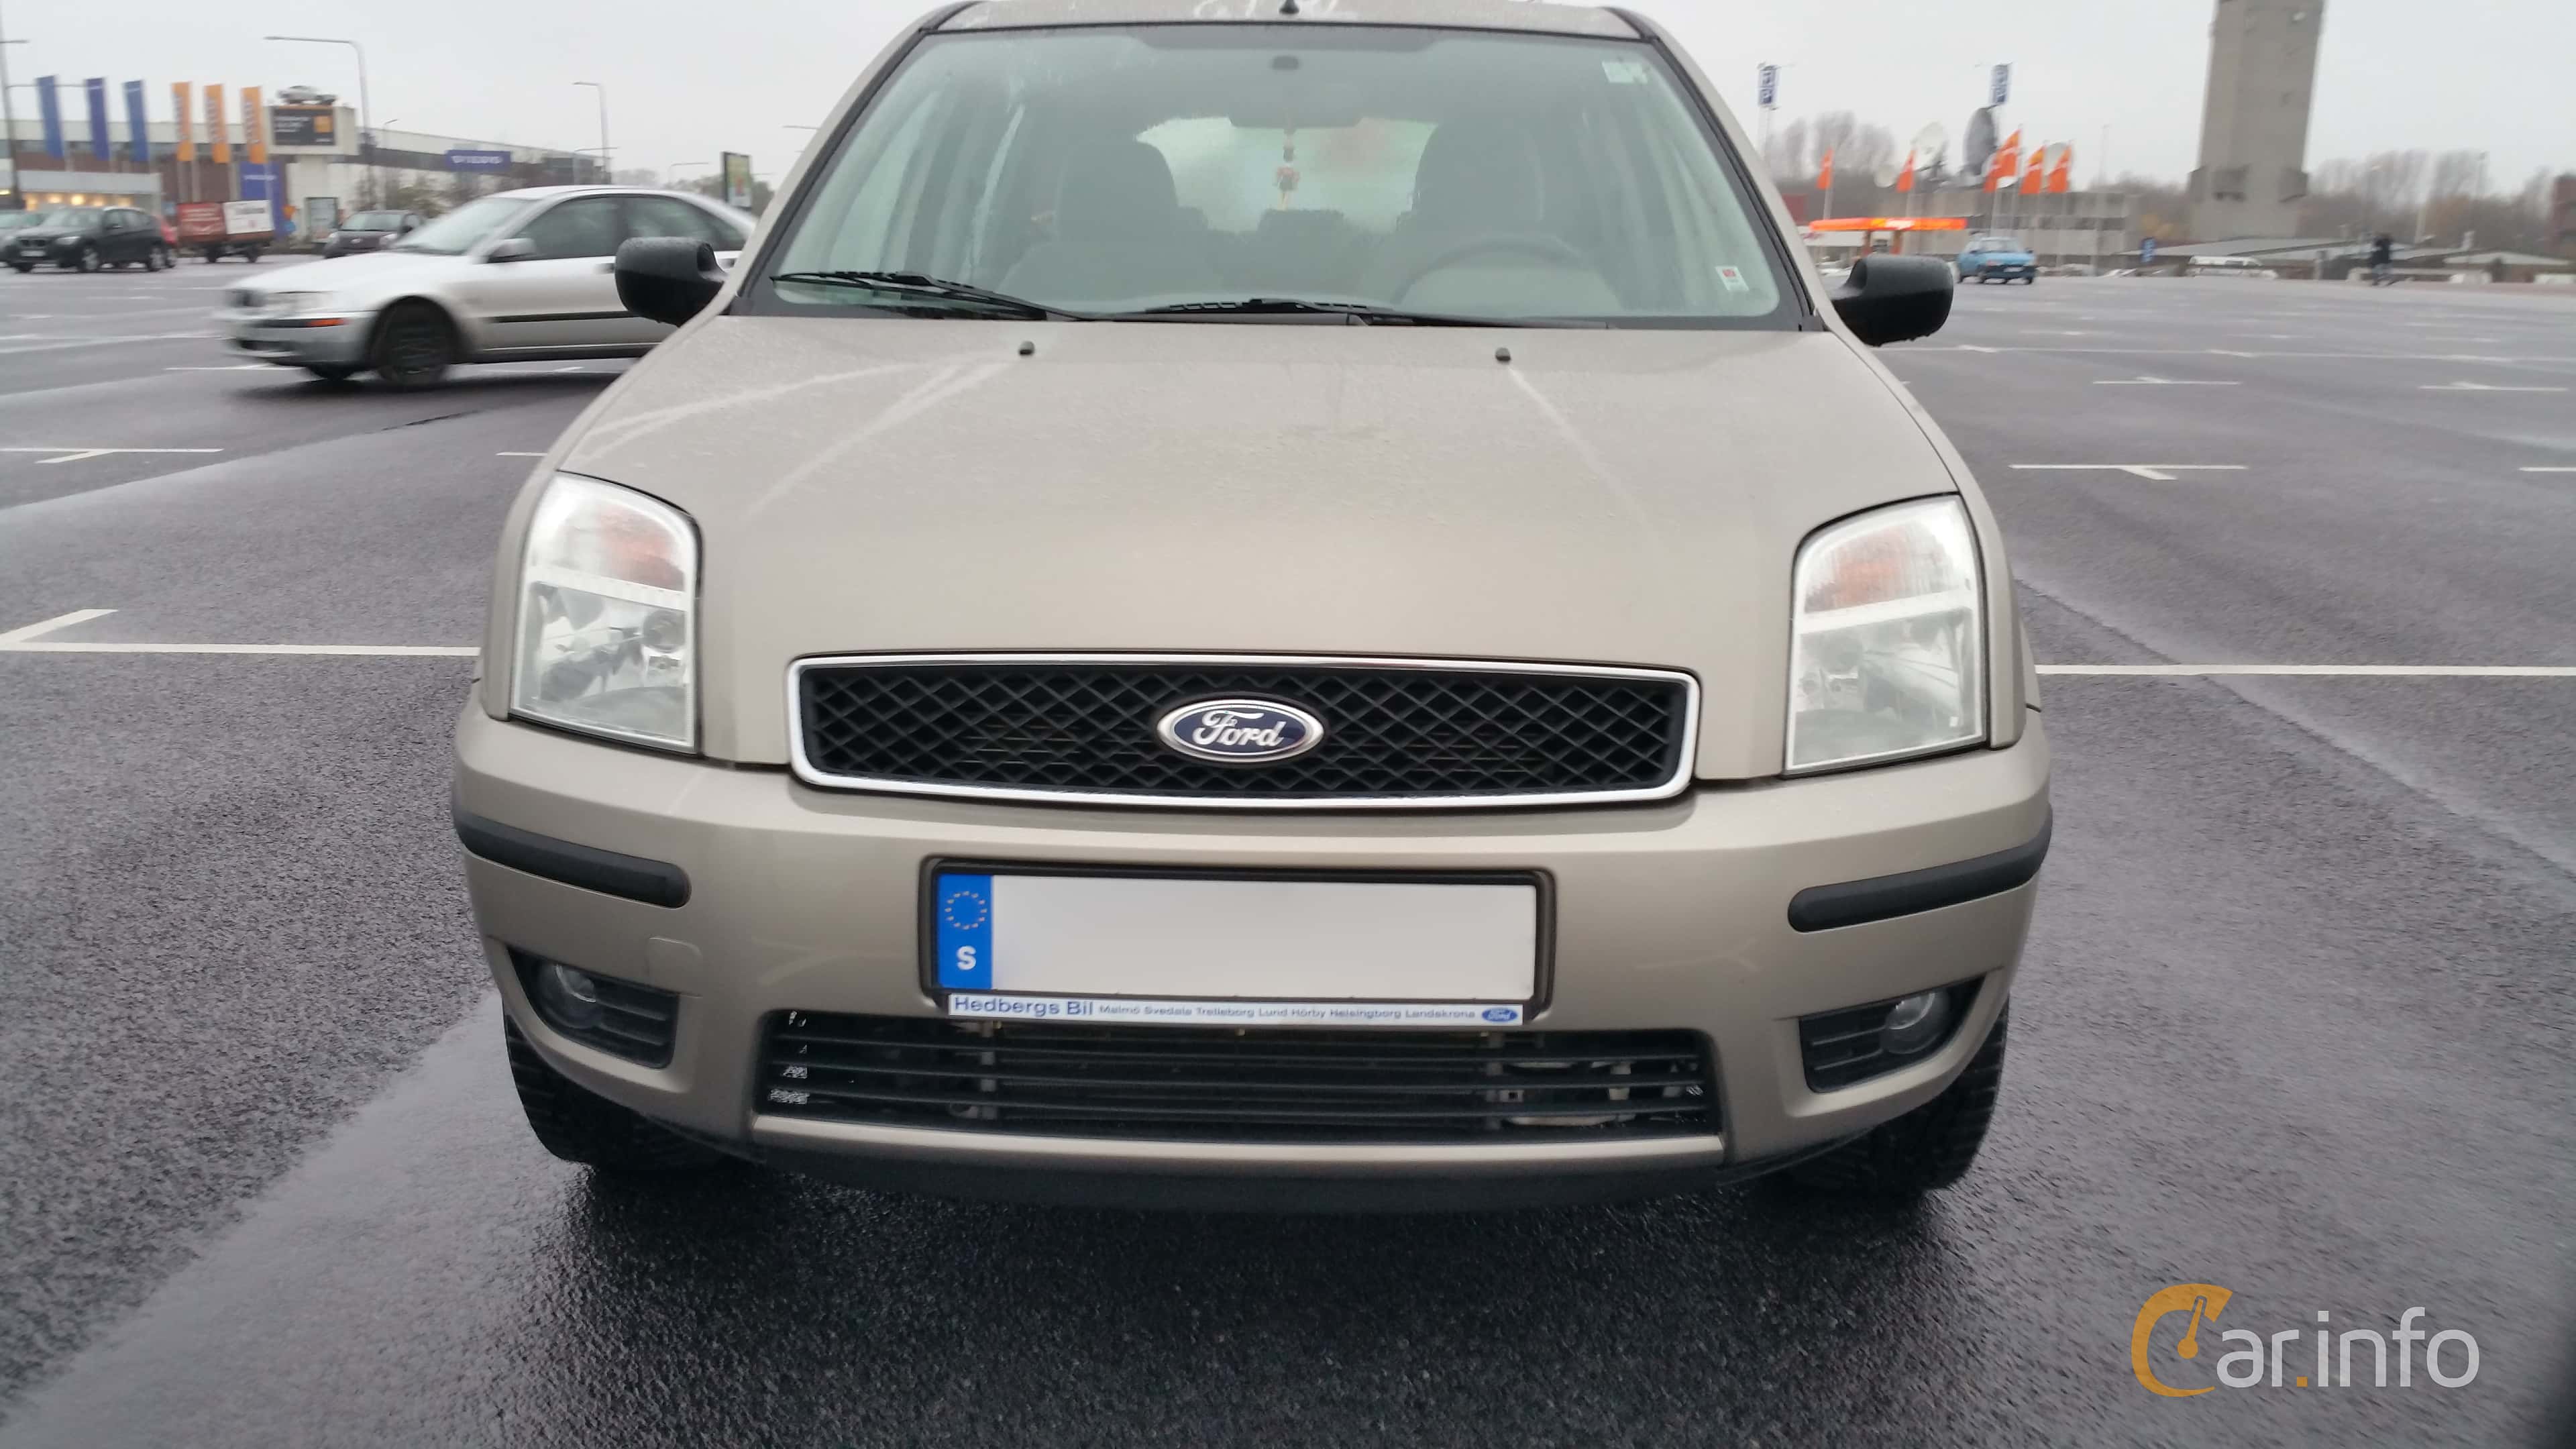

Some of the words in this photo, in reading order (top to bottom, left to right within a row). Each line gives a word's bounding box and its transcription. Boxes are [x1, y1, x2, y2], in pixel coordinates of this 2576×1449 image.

[1192, 710, 1286, 747] Ford
[957, 945, 977, 971] S
[955, 996, 1060, 1017] Hedbergs
[1067, 1001, 1093, 1016] Bil
[1197, 1007, 1255, 1018] Trelleborg
[1258, 1008, 1288, 1017] Lund
[1330, 1009, 1401, 1020] Helsingborg
[1405, 1009, 1475, 1018] Landskrona
